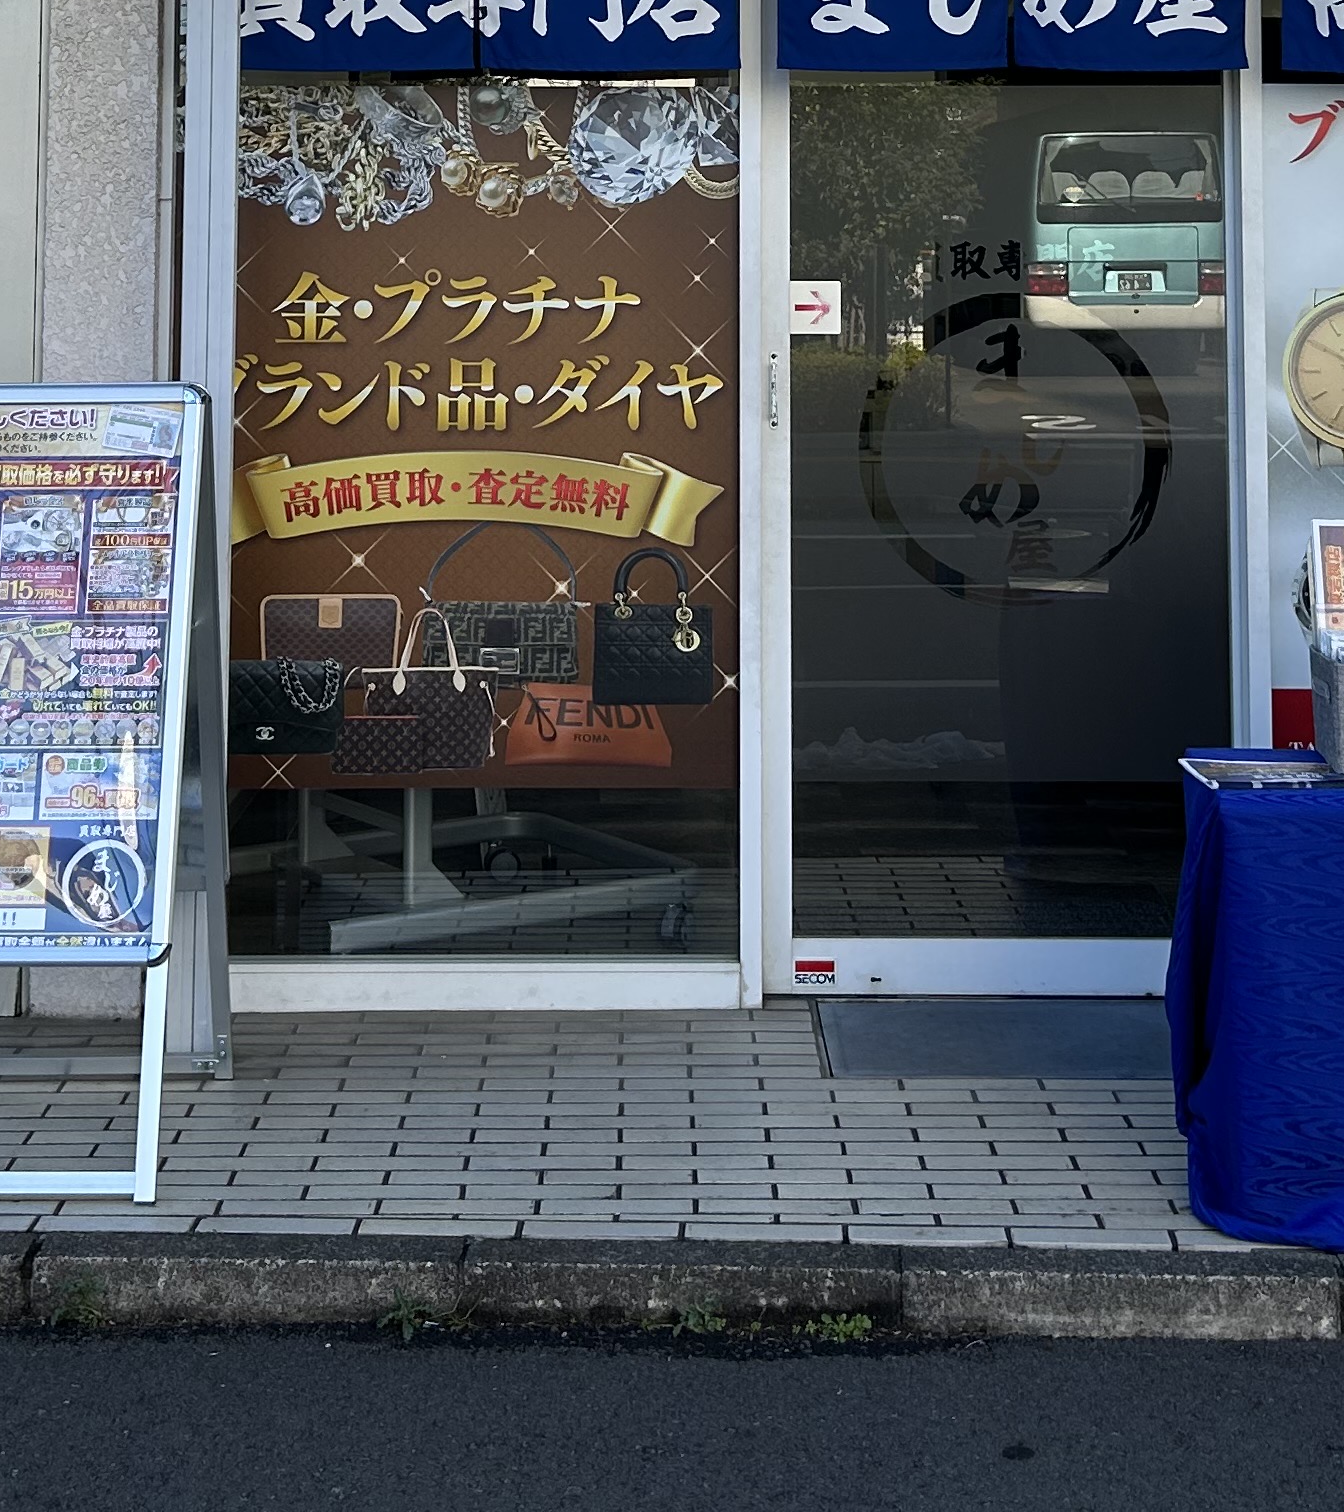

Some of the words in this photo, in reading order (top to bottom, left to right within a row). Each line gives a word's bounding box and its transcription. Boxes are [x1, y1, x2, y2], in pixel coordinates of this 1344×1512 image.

[271, 269, 642, 345] 金・プラチナ
[281, 468, 631, 523] 高価買取・査定無料
[524, 697, 655, 730] FENDI
[574, 734, 611, 744] ROMA
[794, 973, 836, 985] SECOM
